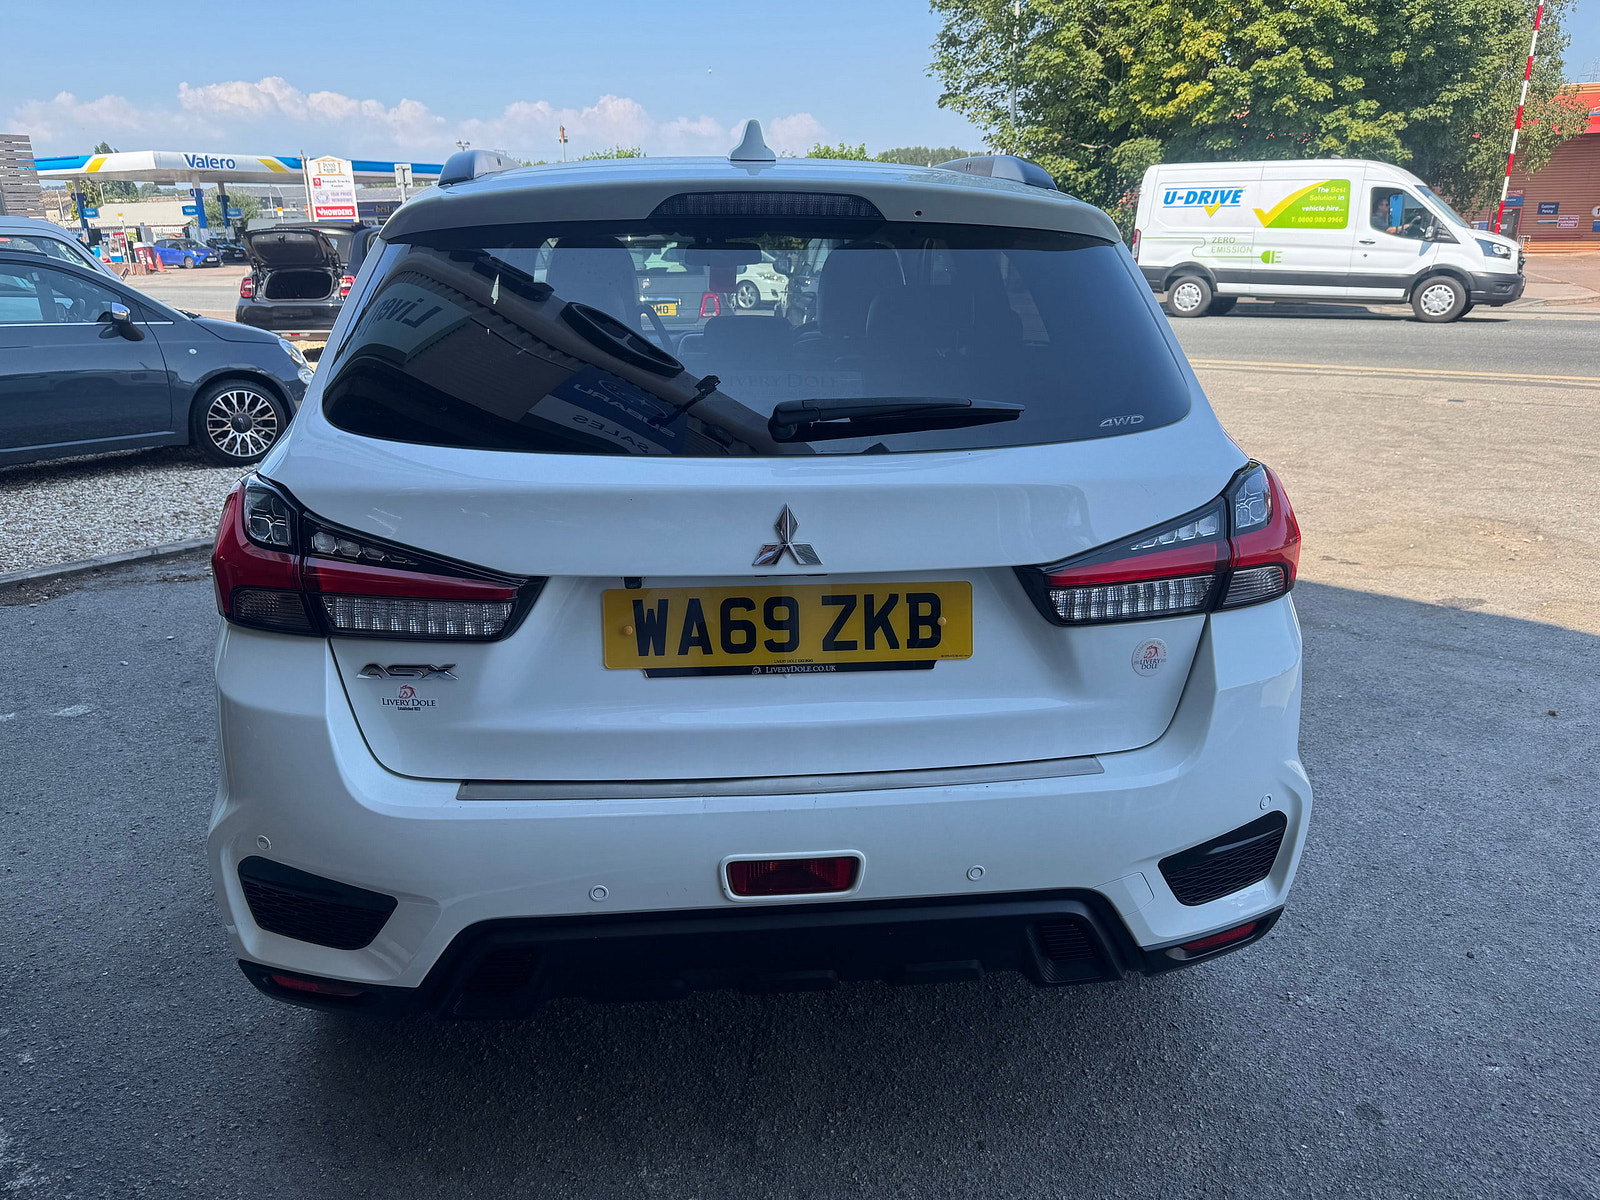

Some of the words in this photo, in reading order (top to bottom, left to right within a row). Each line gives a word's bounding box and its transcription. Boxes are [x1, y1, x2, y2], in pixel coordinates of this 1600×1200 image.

[183, 153, 236, 169] Valero
[1163, 189, 1243, 205] U-DRIVE
[322, 208, 354, 216] HOWDENS
[1211, 236, 1236, 244] ZERO
[1211, 246, 1253, 254] EMISSION
[1100, 415, 1144, 427] 4WD
[632, 596, 799, 657] WA69
[821, 592, 943, 652] ZKB
[356, 664, 459, 680] ASX
[382, 698, 410, 706] LIVERY
[412, 699, 436, 707] DOLE
